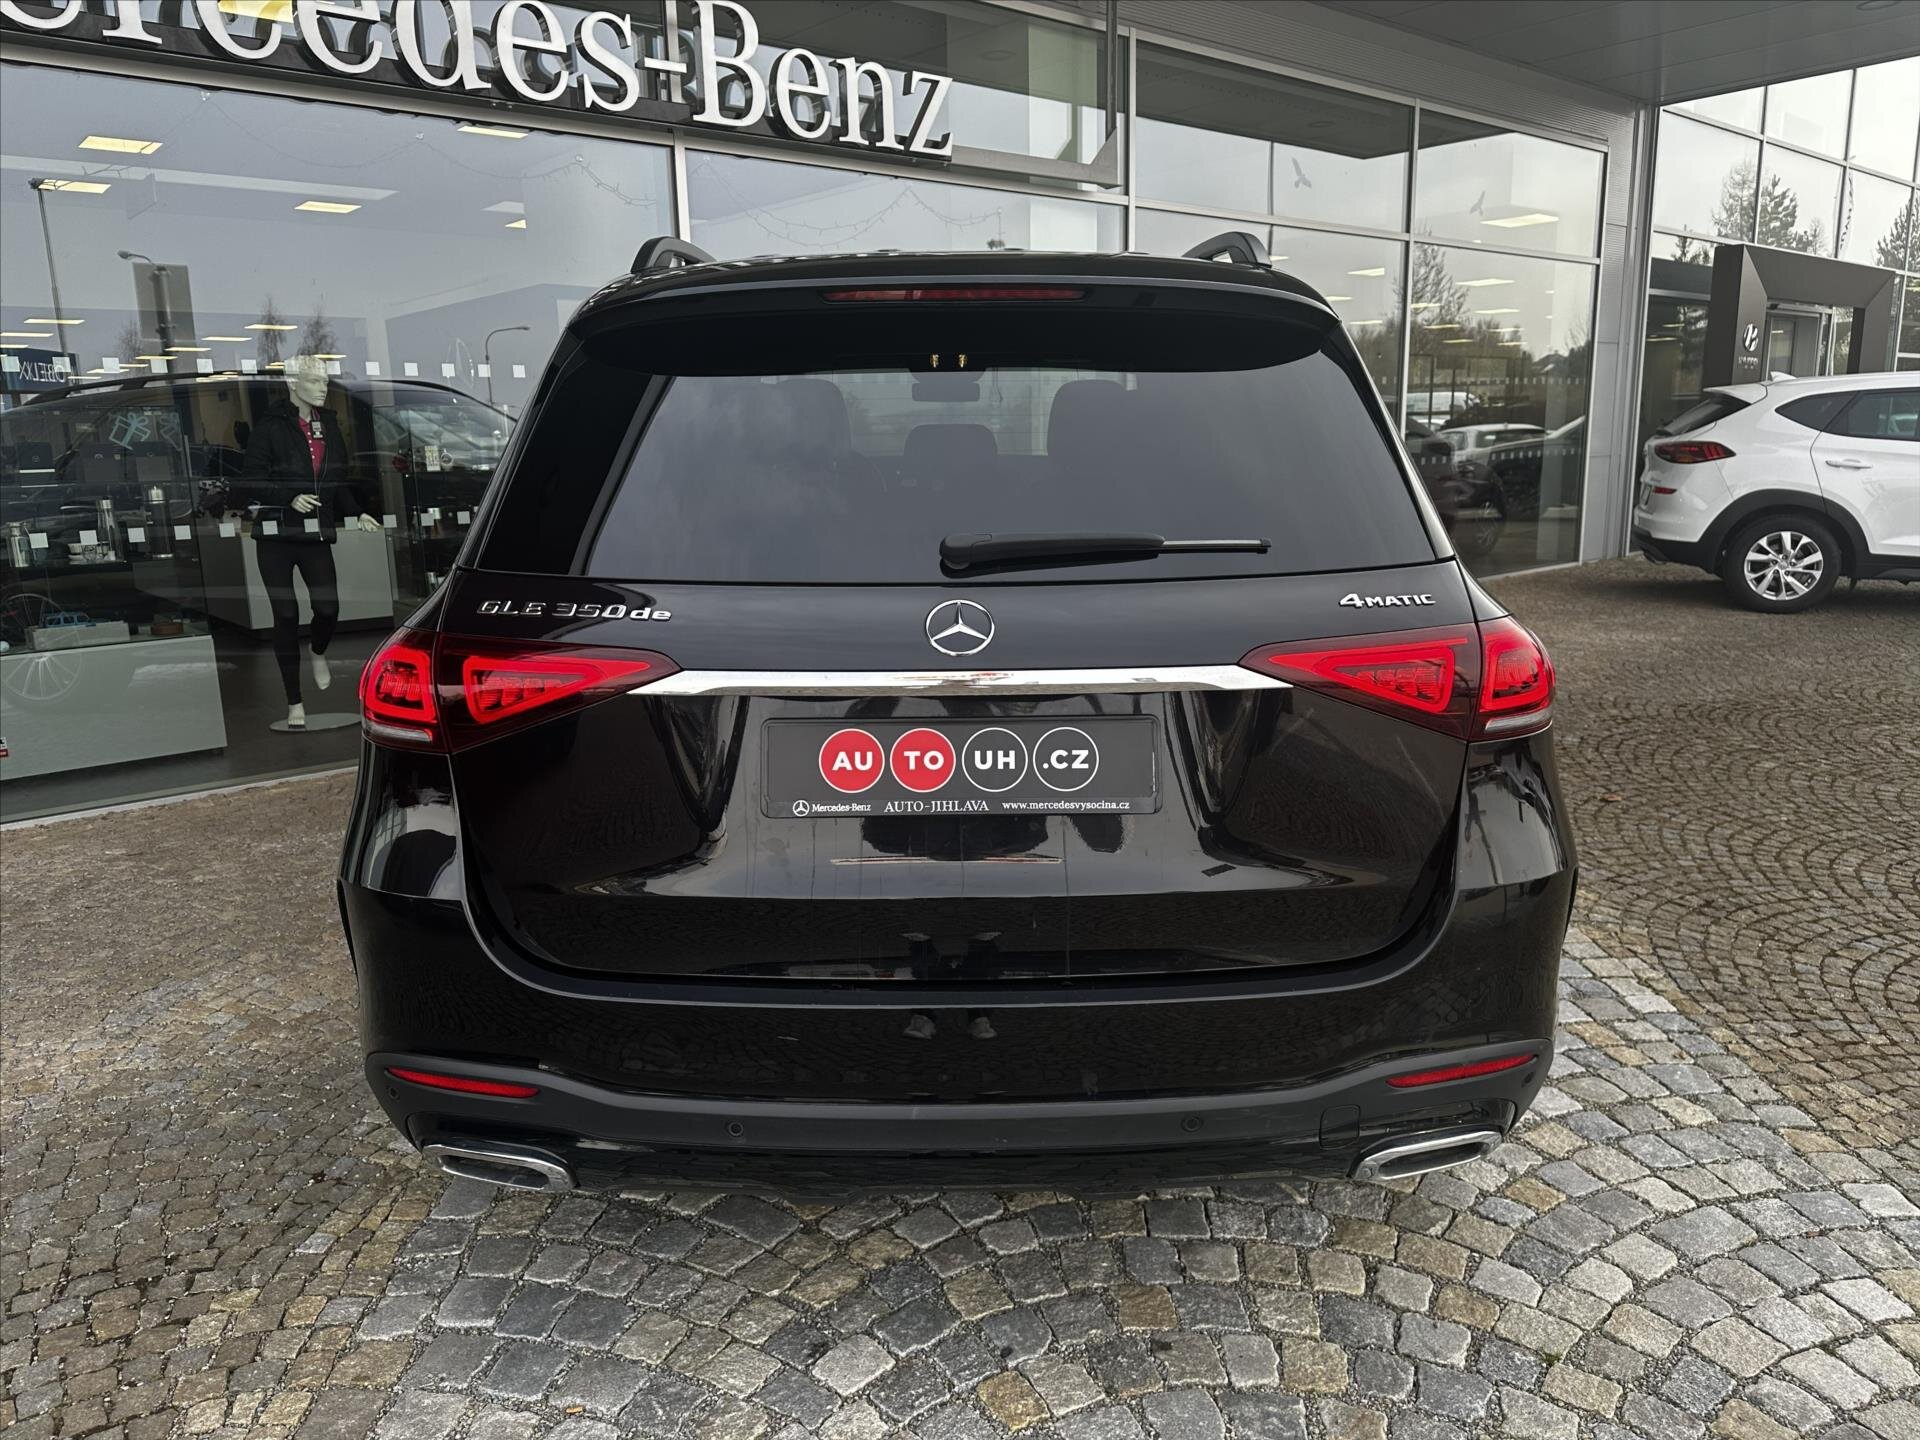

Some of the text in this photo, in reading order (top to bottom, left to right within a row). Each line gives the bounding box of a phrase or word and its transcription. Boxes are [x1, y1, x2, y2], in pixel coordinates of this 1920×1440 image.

[0, 0, 953, 157] cedes-Benz
[476, 600, 546, 615] GLE
[1339, 593, 1436, 608] 4MATIC
[811, 803, 872, 813] Mercedes-Benz
[884, 800, 989, 813] AUTO-JIHLAVA
[1001, 800, 1130, 811] www.mercedesvysocina.cz
